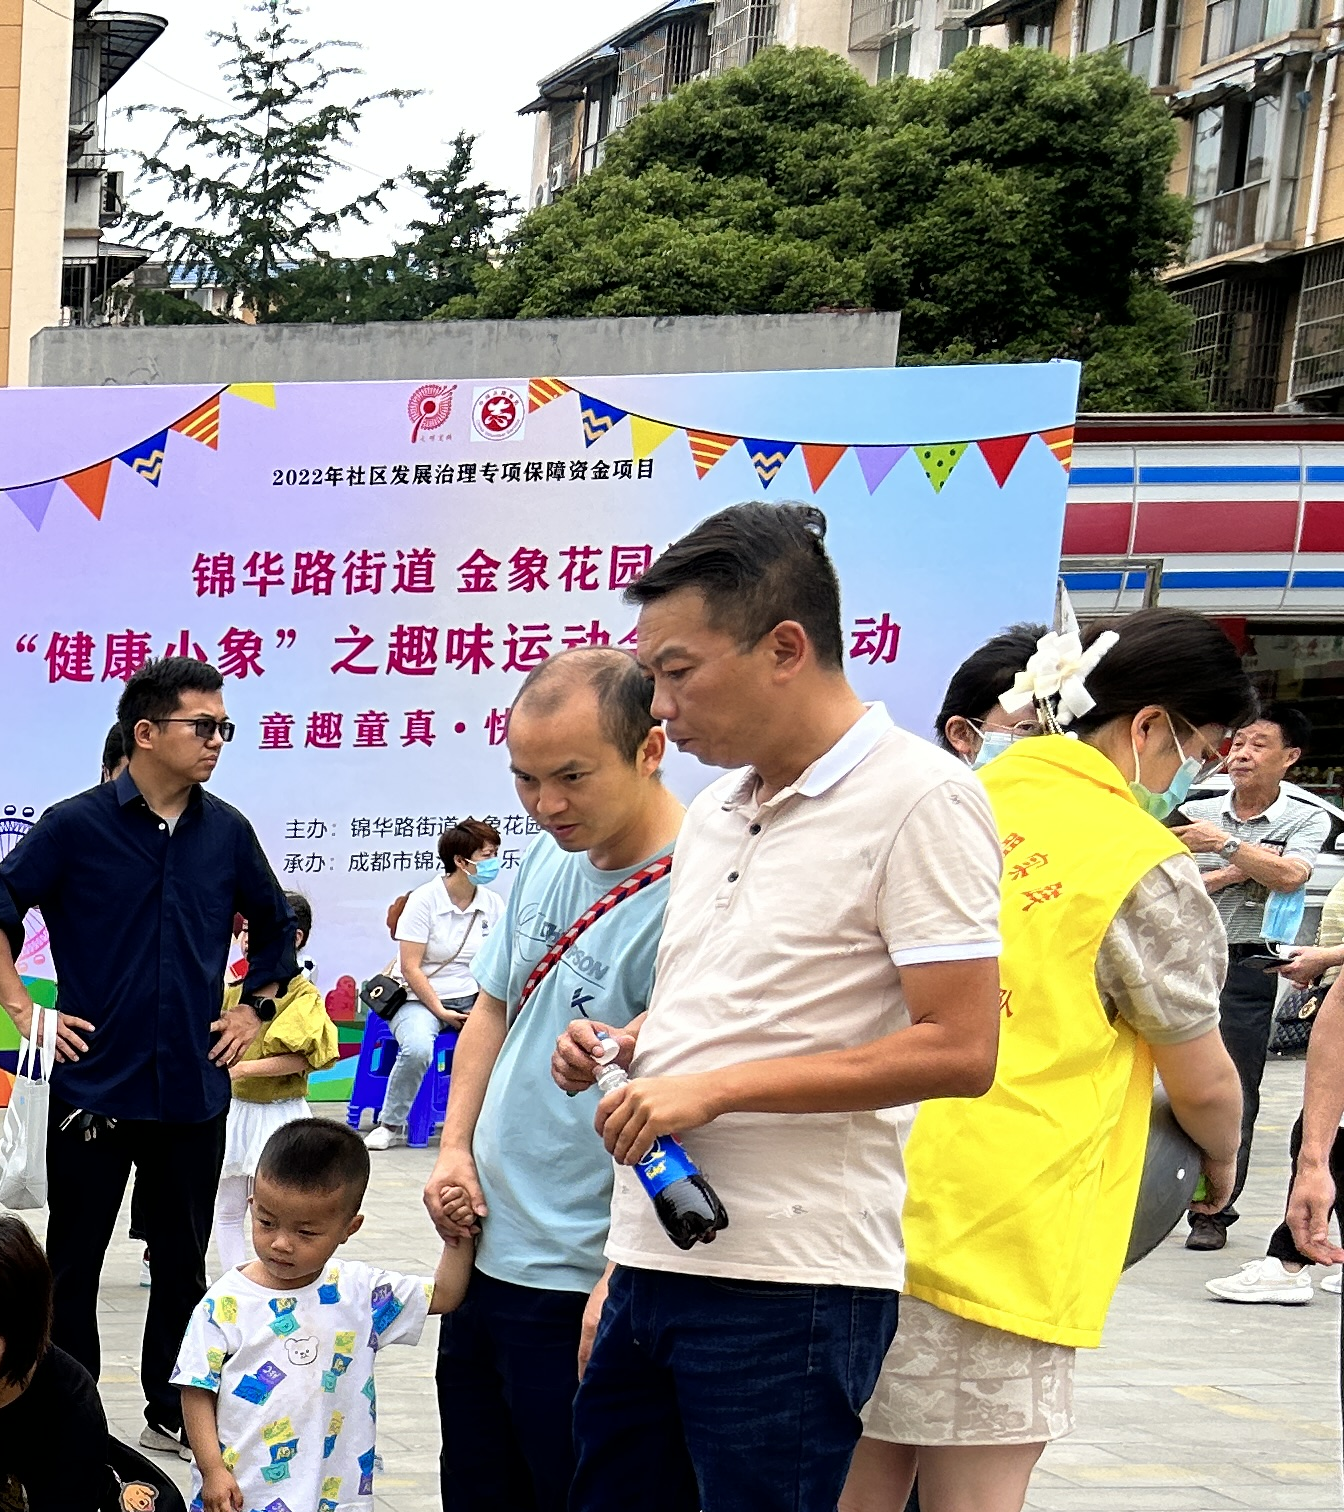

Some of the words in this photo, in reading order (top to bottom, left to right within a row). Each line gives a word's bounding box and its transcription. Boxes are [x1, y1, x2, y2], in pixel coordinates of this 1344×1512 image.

[272, 458, 655, 487] 2022年社区发展治理专项保障资金项目
[191, 547, 437, 599] 锦华路街道
